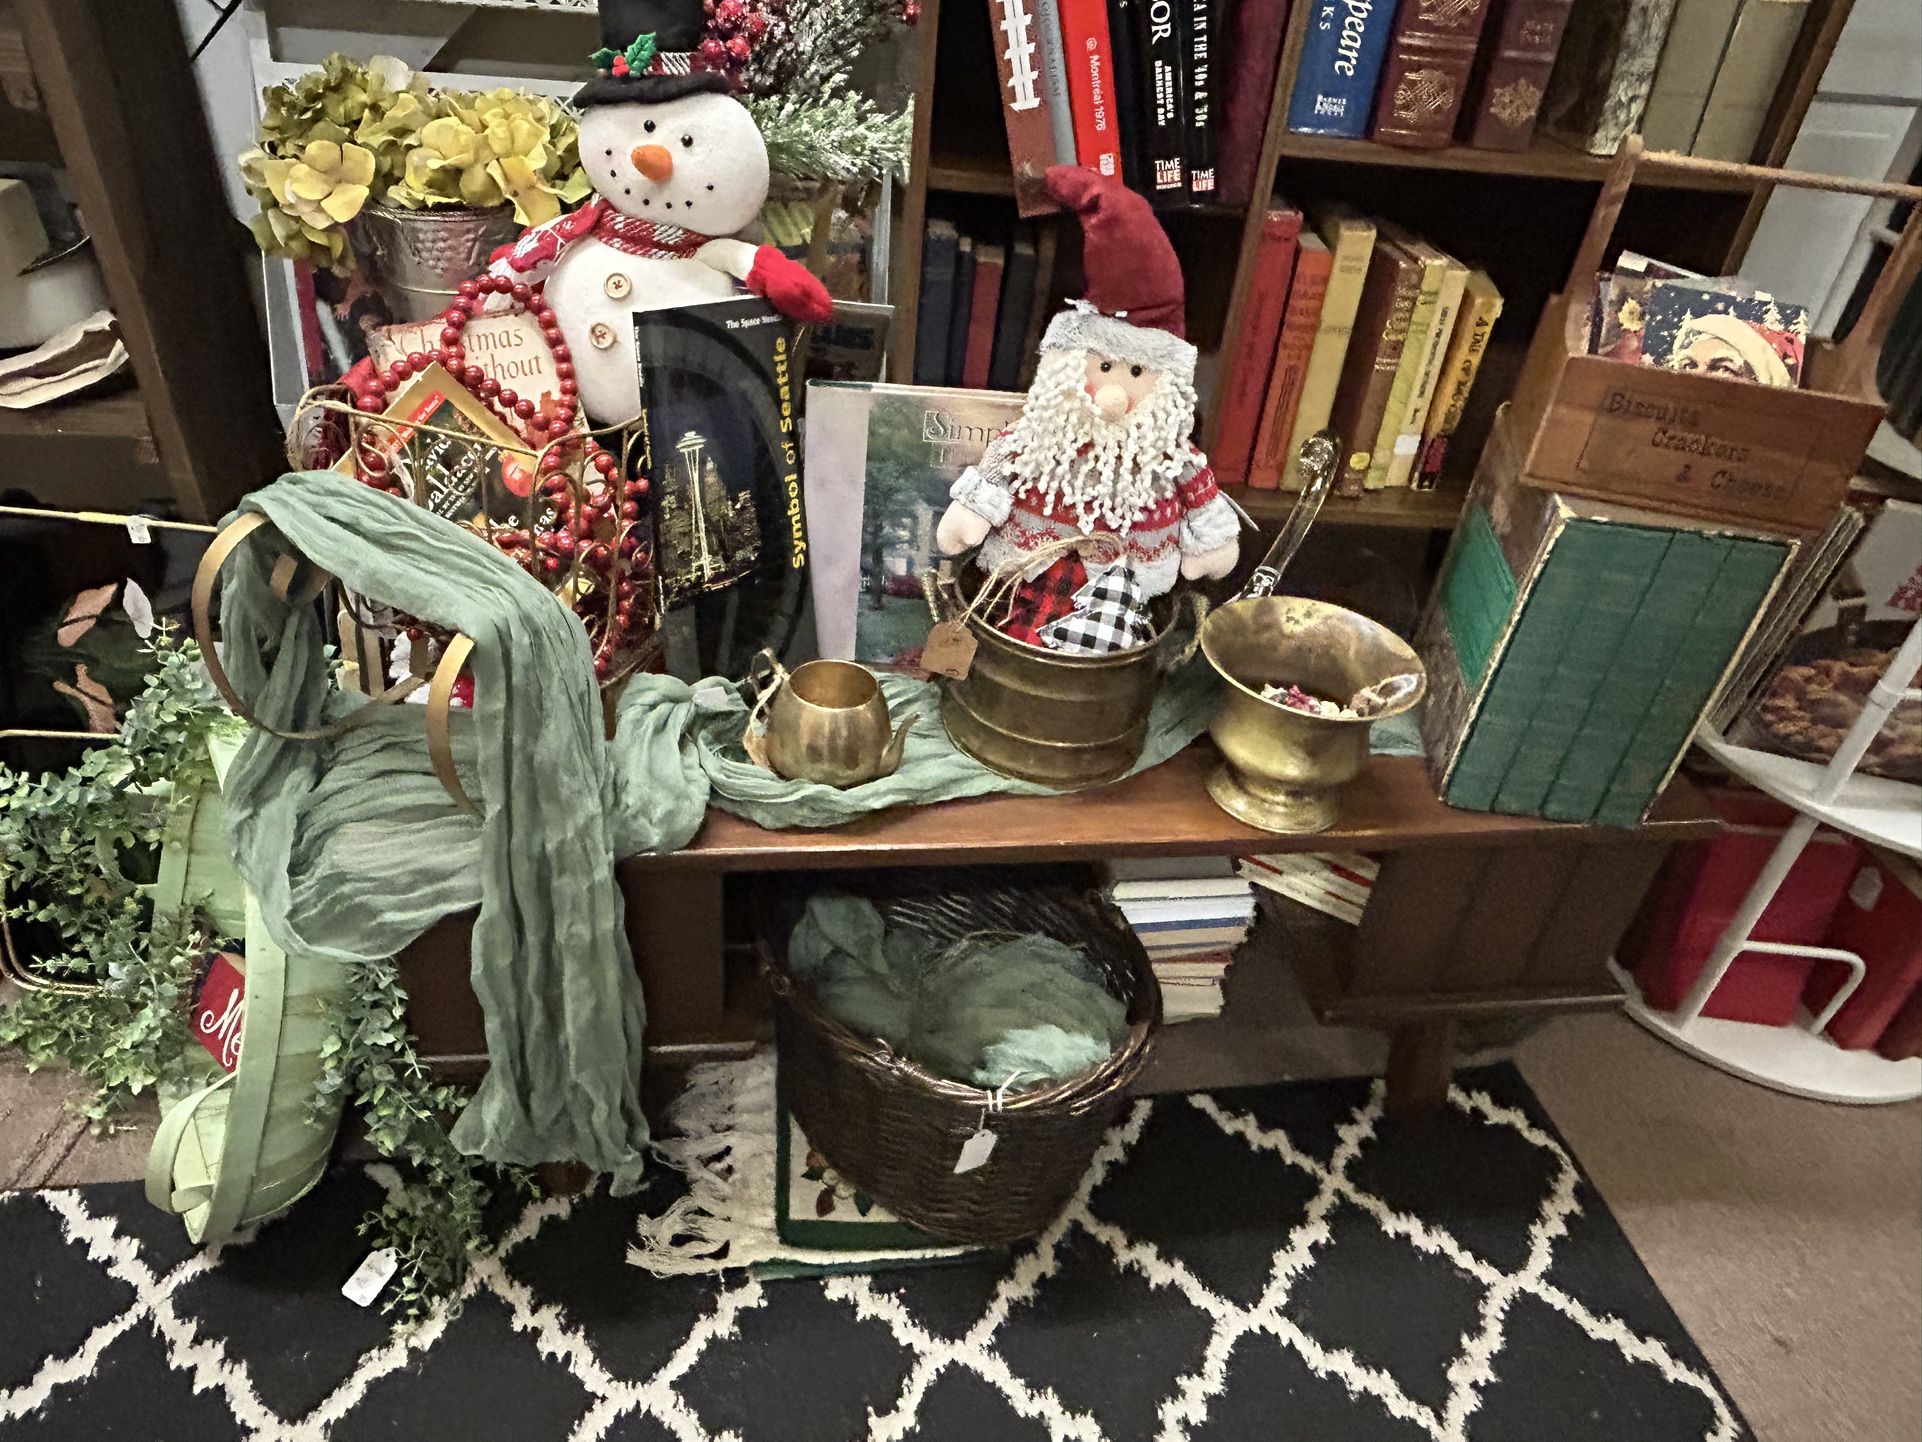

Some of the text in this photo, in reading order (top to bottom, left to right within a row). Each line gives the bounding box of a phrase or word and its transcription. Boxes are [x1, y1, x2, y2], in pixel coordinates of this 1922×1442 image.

[1193, 16, 1207, 31] IN
[1193, 35, 1208, 60] THE
[1164, 65, 1174, 119] AMERICA'S
[1194, 92, 1208, 100] &
[1157, 107, 1166, 126] DAY
[1154, 158, 1181, 171] TIME
[1156, 170, 1182, 183] LIFE
[1191, 168, 1214, 181] TIME
[1192, 180, 1215, 192] LIFE
[725, 319, 740, 329] The
[740, 316, 761, 329] Space
[773, 336, 806, 569] Symbol of Seattle
